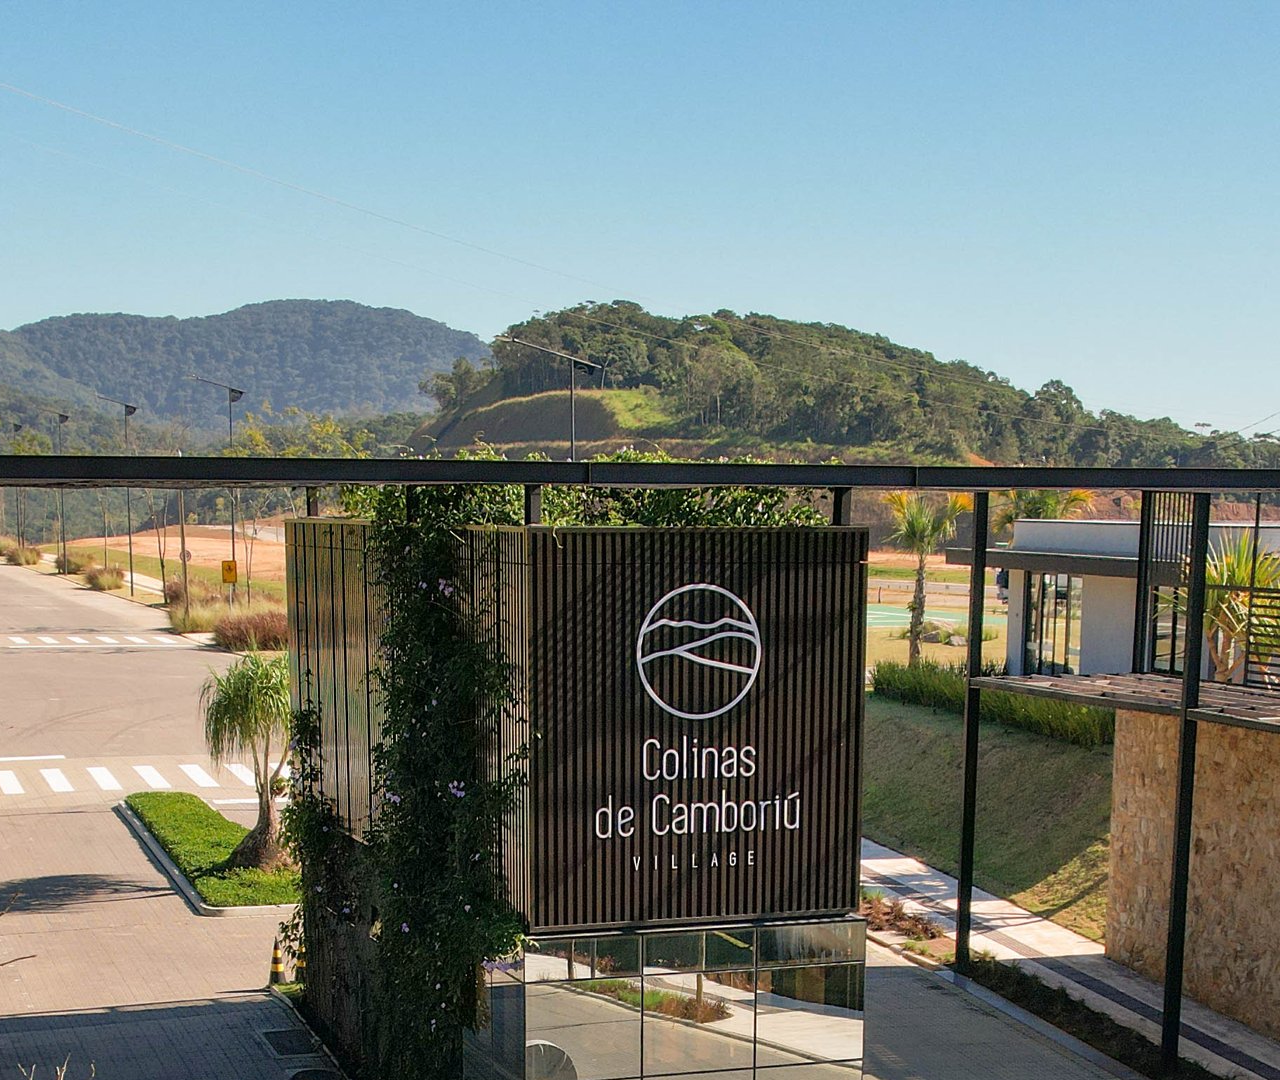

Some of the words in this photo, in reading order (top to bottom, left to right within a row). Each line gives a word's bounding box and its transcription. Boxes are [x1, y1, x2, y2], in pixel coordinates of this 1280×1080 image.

[642, 736, 756, 781] Colinas
[595, 795, 635, 839] de
[652, 790, 800, 836] Camboriú
[633, 851, 755, 872] VILLAGE
